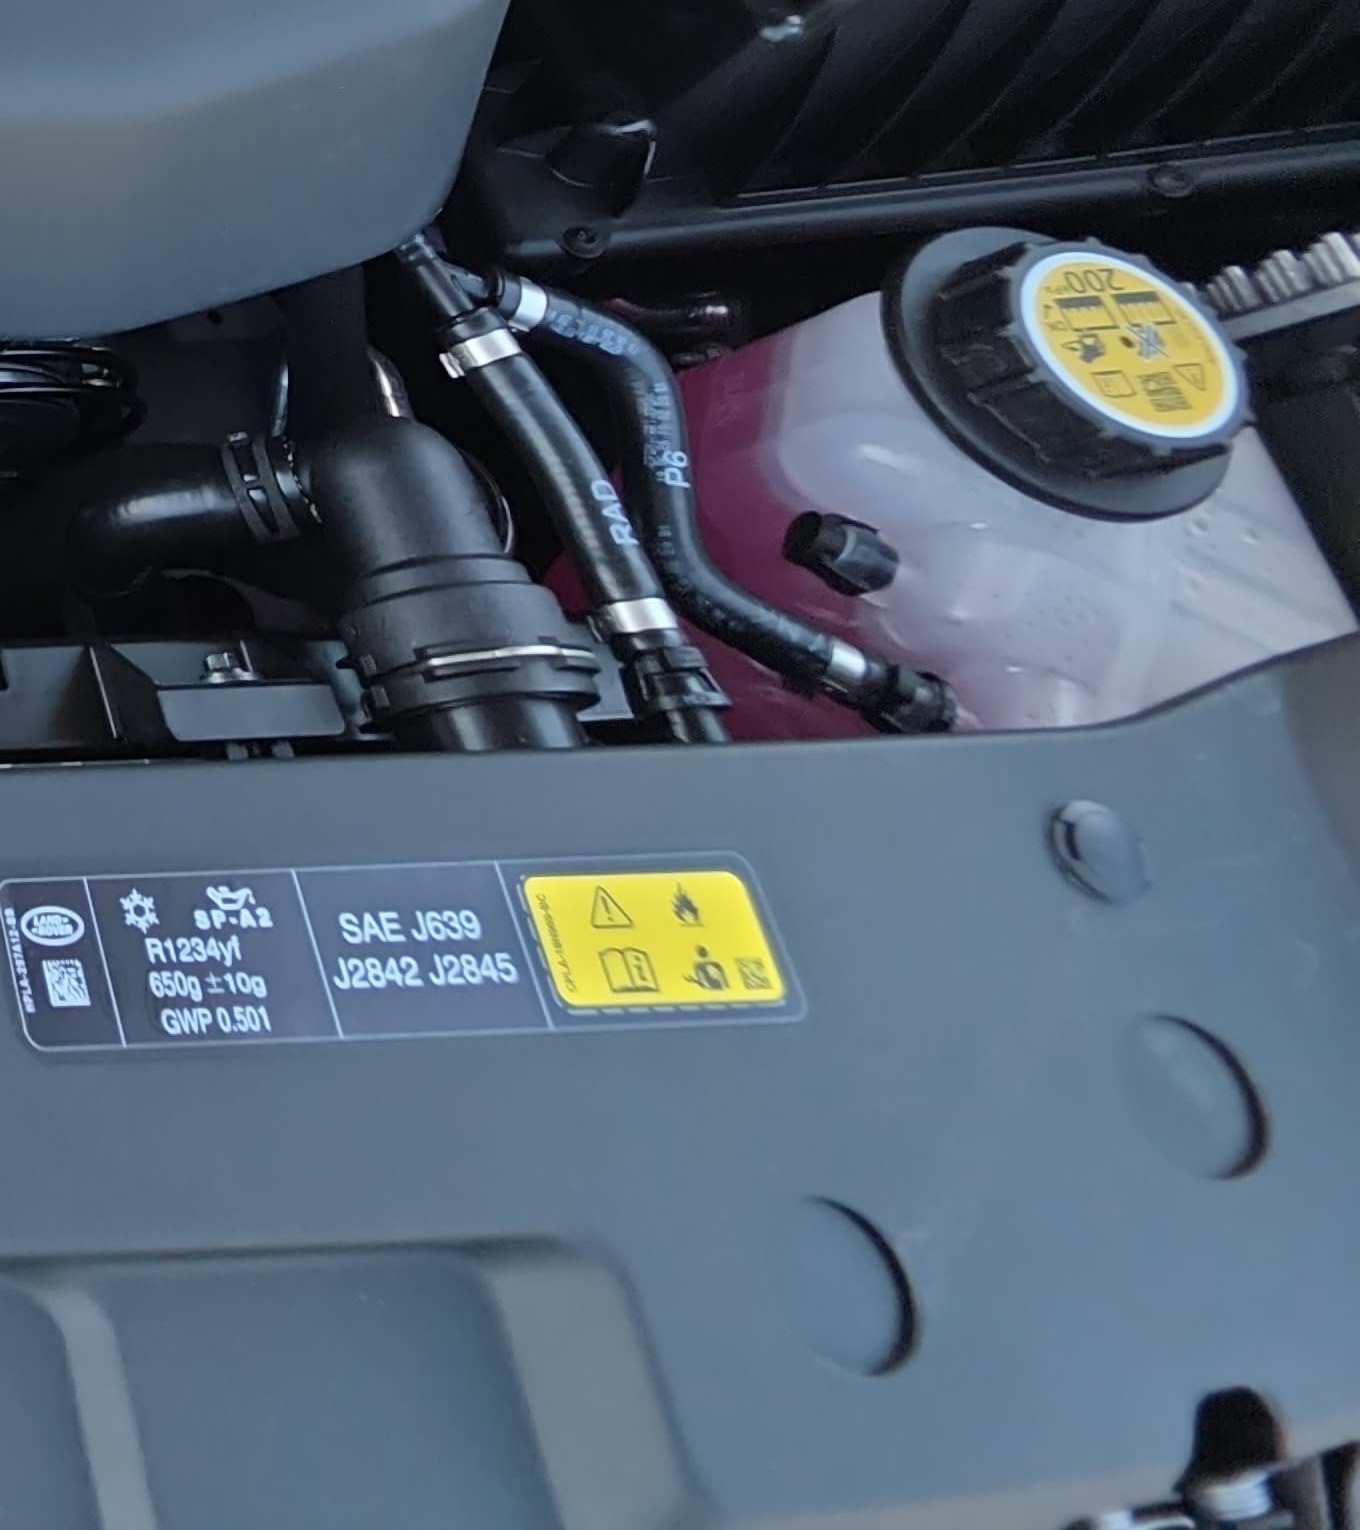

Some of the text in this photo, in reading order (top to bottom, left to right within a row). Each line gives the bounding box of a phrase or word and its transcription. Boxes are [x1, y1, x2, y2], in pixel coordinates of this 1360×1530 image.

[1063, 268, 1124, 294] 200
[664, 451, 691, 488] P6
[591, 479, 640, 545] RAD
[193, 906, 274, 931] SP-A2
[338, 909, 482, 944] SAE J639
[149, 970, 203, 1003] 650g
[332, 952, 520, 990] J2842 J2845
[160, 1005, 272, 1036] GWP 0.501
